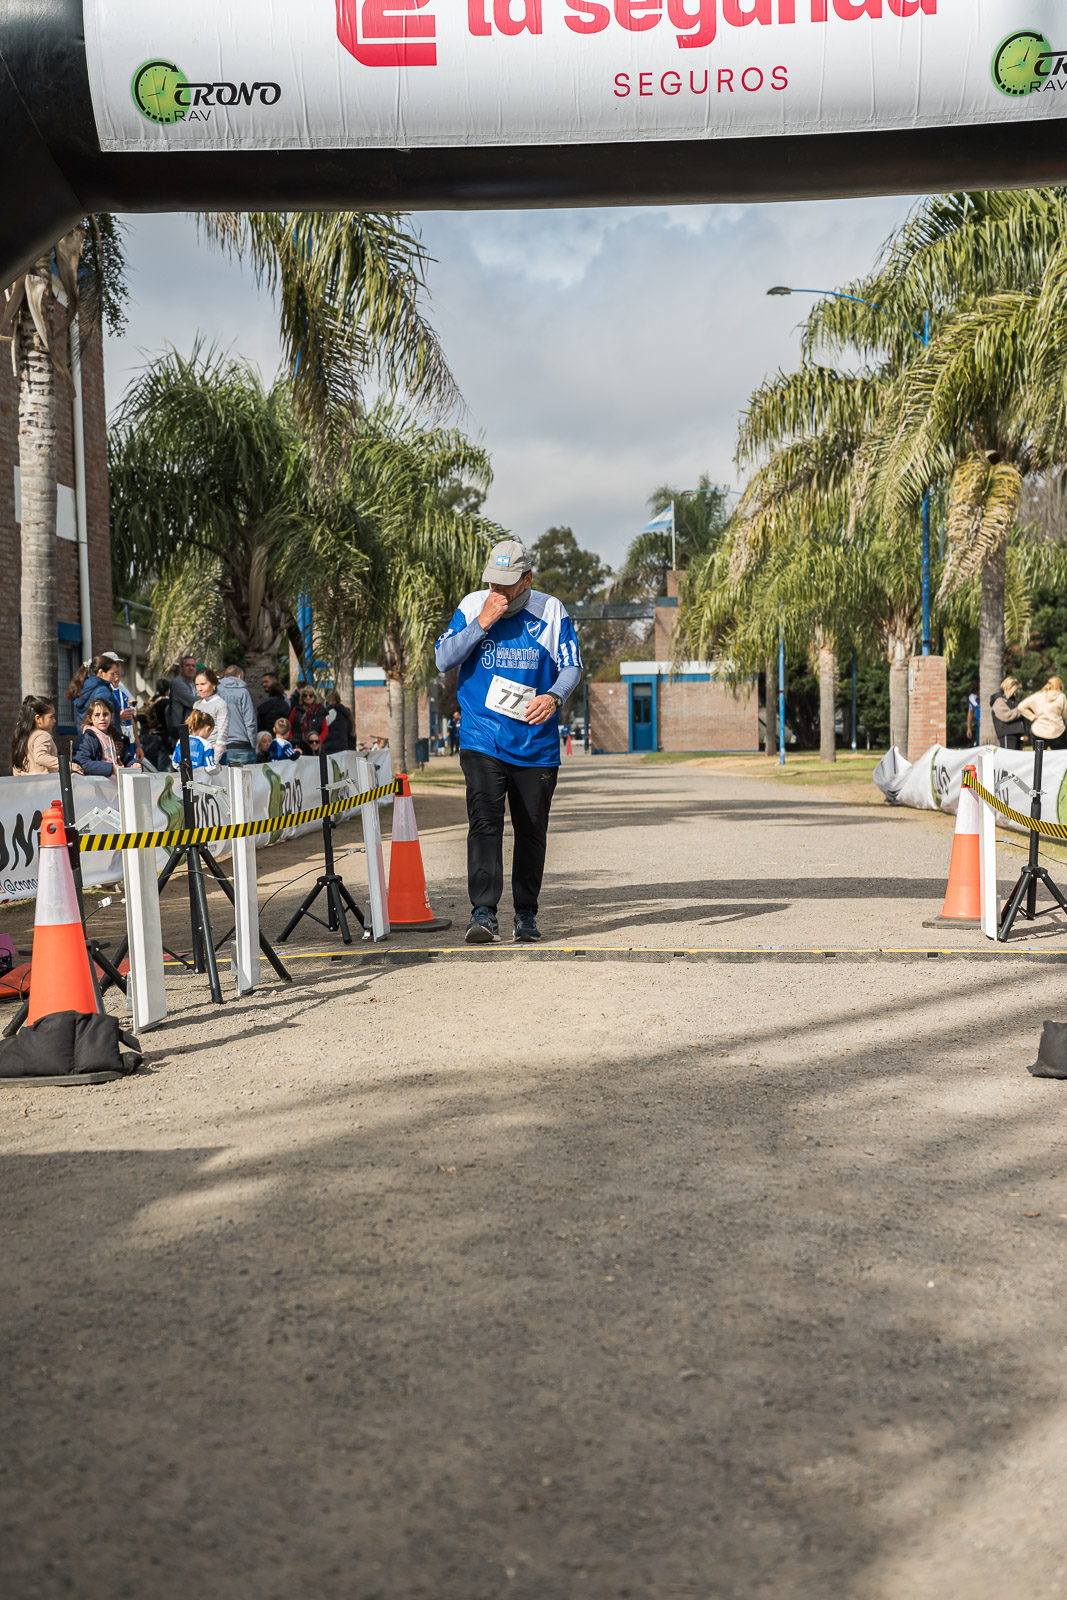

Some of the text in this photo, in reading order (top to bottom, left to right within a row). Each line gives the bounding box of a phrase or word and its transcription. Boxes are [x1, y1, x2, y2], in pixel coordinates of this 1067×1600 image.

[564, 0, 937, 49] segu
[613, 66, 789, 97] SEGUROS
[174, 82, 281, 106] CRONO
[174, 110, 212, 122] RAV
[481, 639, 496, 670] 3
[498, 688, 524, 710] 77
[3, 878, 39, 895] @crono
